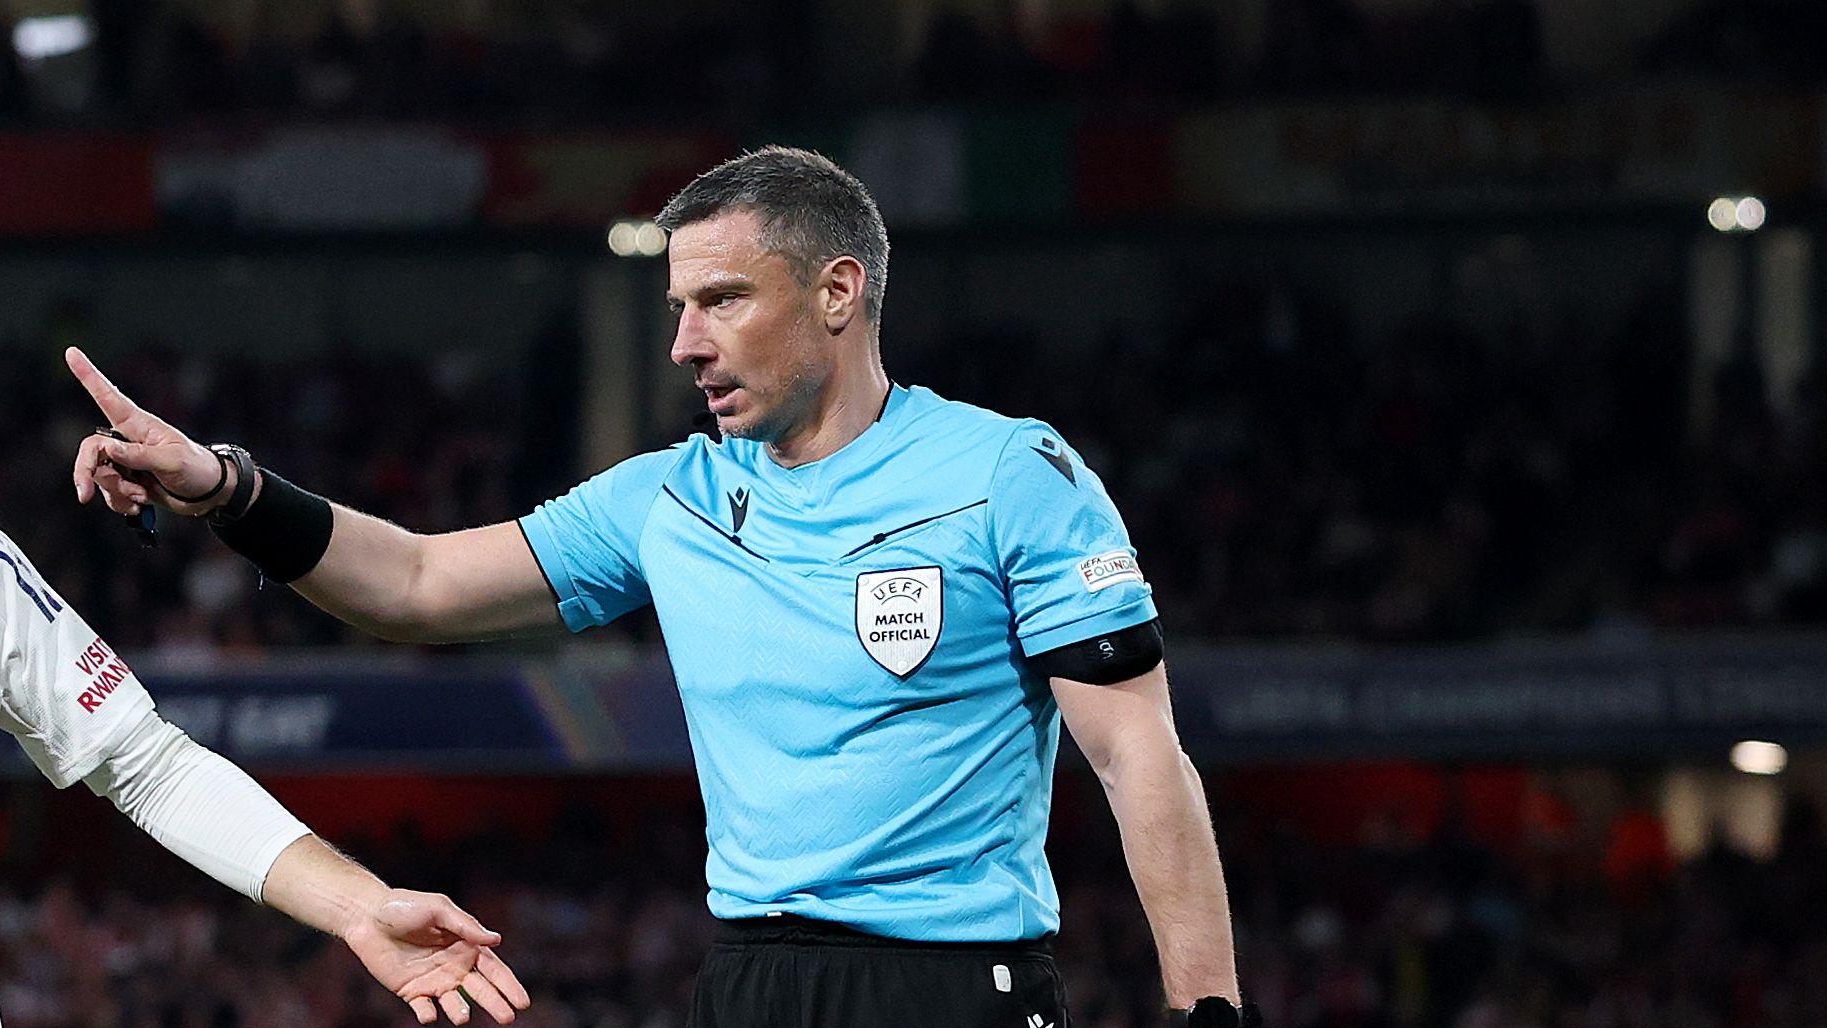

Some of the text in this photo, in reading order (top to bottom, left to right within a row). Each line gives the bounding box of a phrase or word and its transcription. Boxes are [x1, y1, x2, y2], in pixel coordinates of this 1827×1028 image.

[873, 581, 924, 601] UEFA
[875, 612, 924, 626] MATCH
[869, 628, 930, 643] OFFICIAL
[77, 656, 130, 714] RWAN
